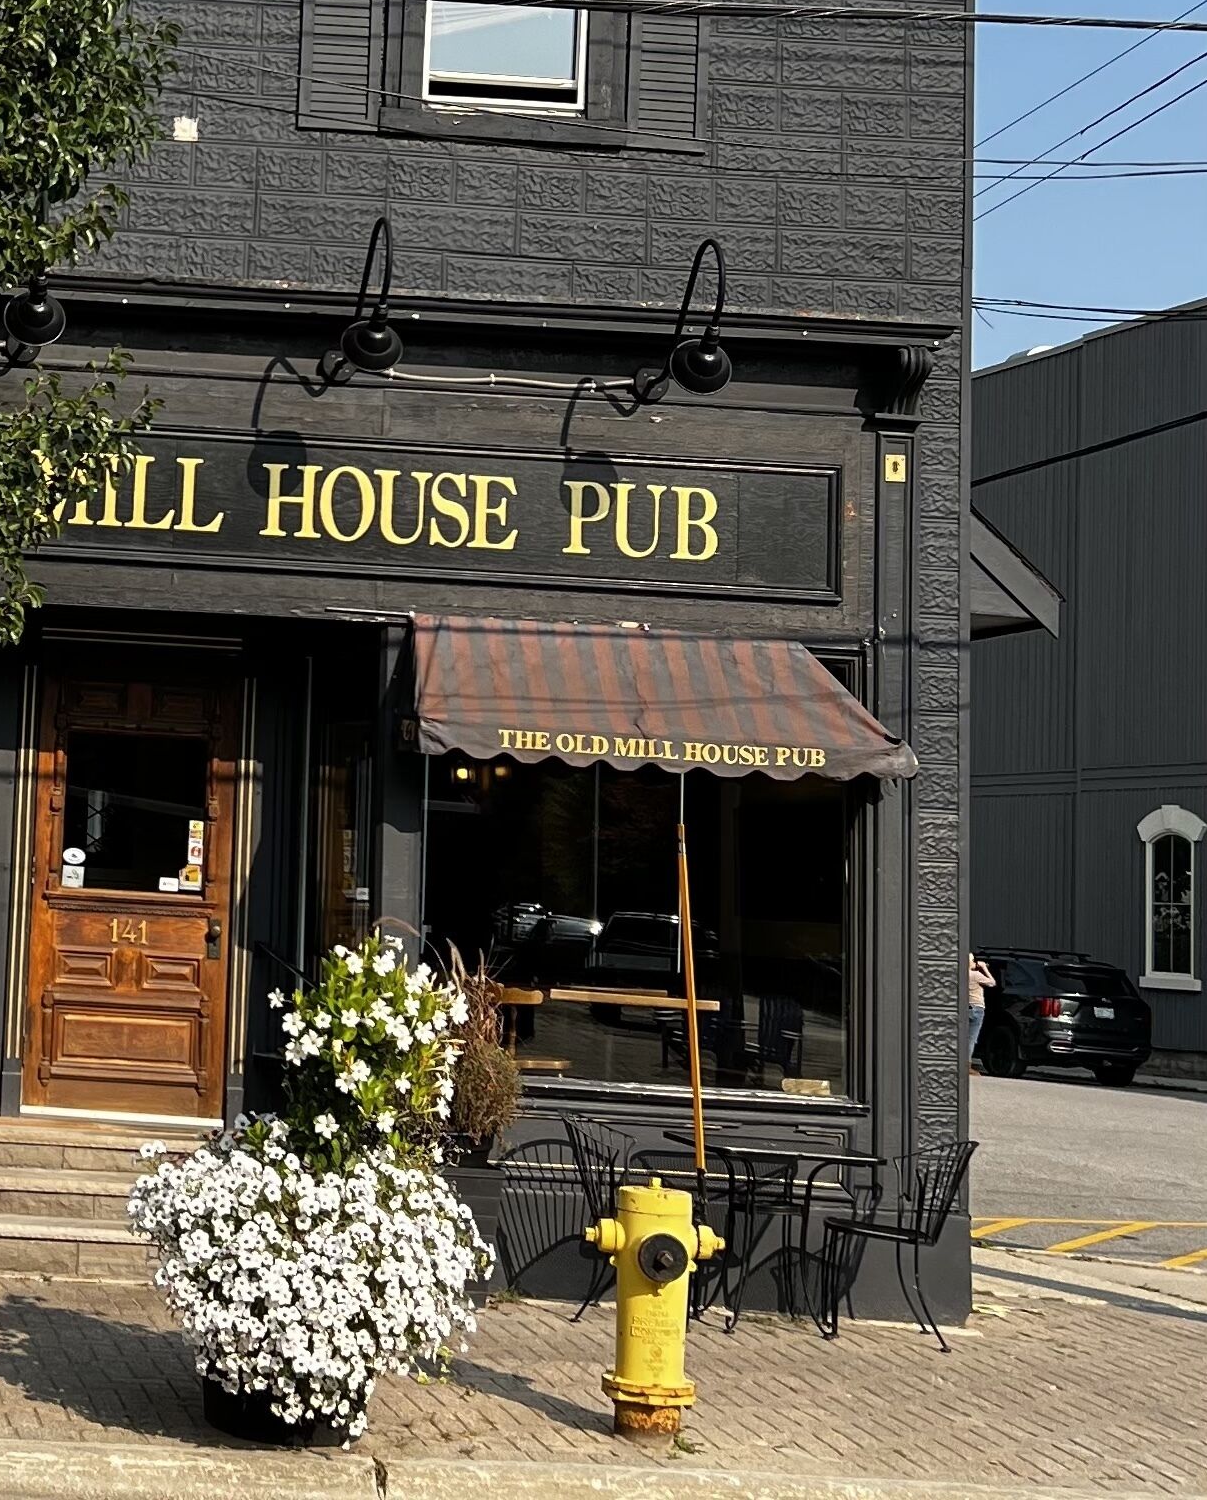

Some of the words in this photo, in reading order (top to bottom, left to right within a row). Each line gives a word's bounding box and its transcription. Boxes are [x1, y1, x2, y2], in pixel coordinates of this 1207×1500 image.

[259, 462, 518, 551] HOUSE
[563, 479, 719, 561] PUB
[498, 729, 552, 751] THE
[555, 733, 609, 755] OLD
[613, 737, 679, 760] MILL
[683, 742, 770, 767] HOUSE
[775, 747, 826, 768] PUB
[110, 917, 148, 946] 141
